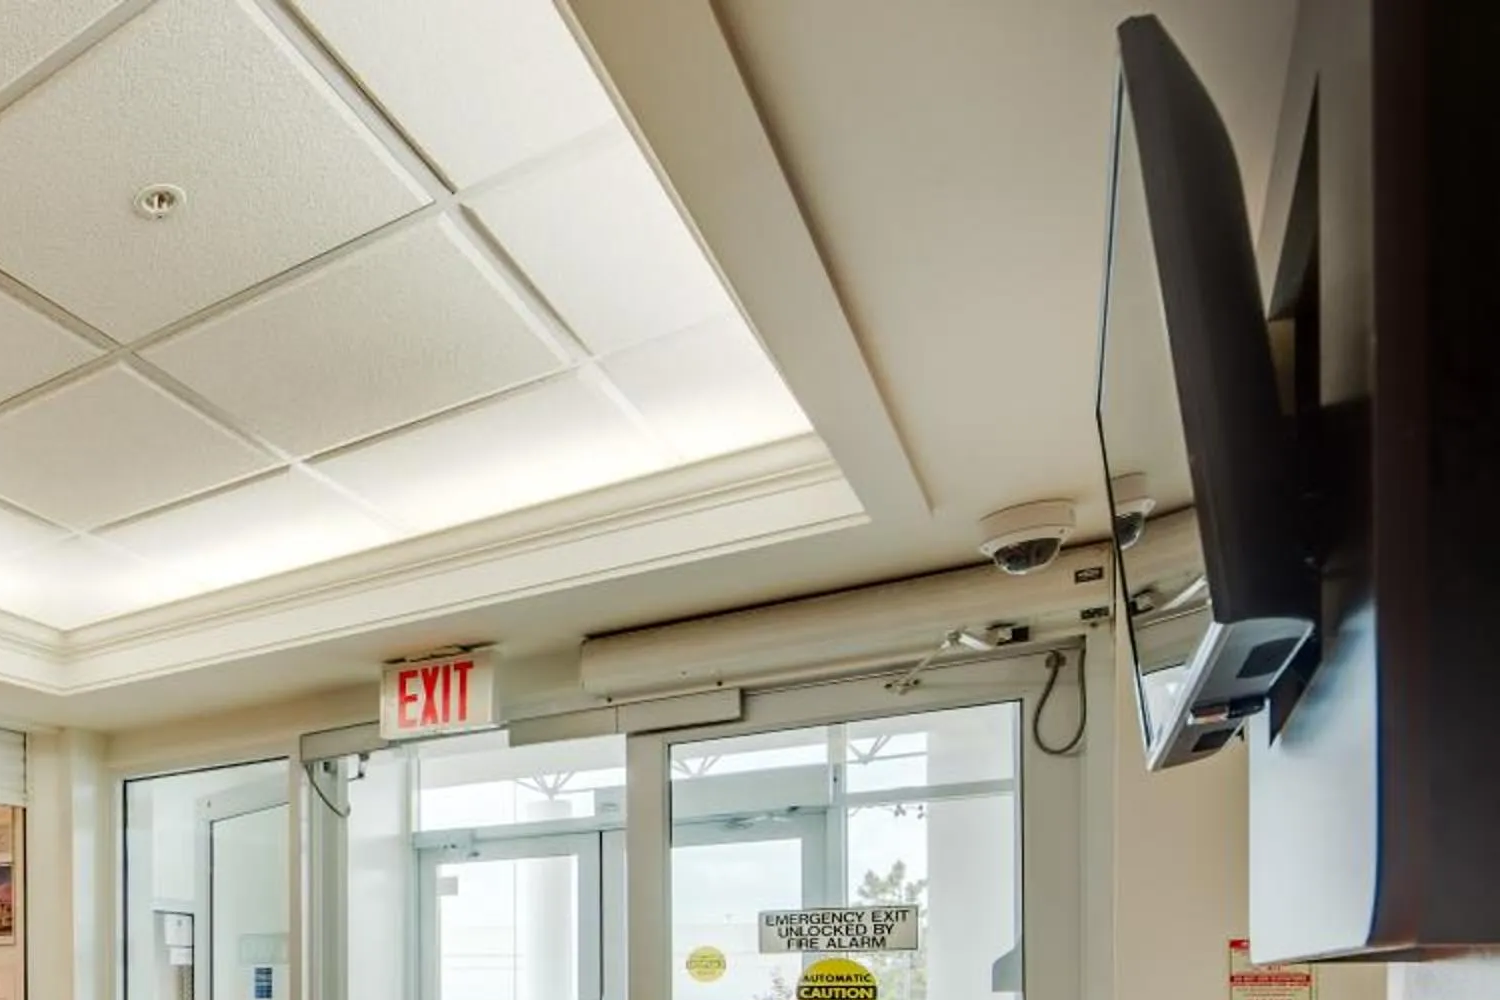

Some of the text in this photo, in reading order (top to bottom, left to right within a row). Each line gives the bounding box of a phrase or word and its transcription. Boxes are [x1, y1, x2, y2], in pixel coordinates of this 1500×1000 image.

[398, 661, 474, 728] EXIT
[765, 910, 910, 926] EMERGENCY EXIT
[778, 923, 895, 938] UNLOCKED BY
[787, 936, 886, 949] FIRE ALARM
[803, 974, 871, 983] AUTOMATIC
[801, 987, 873, 999] CAUTION
